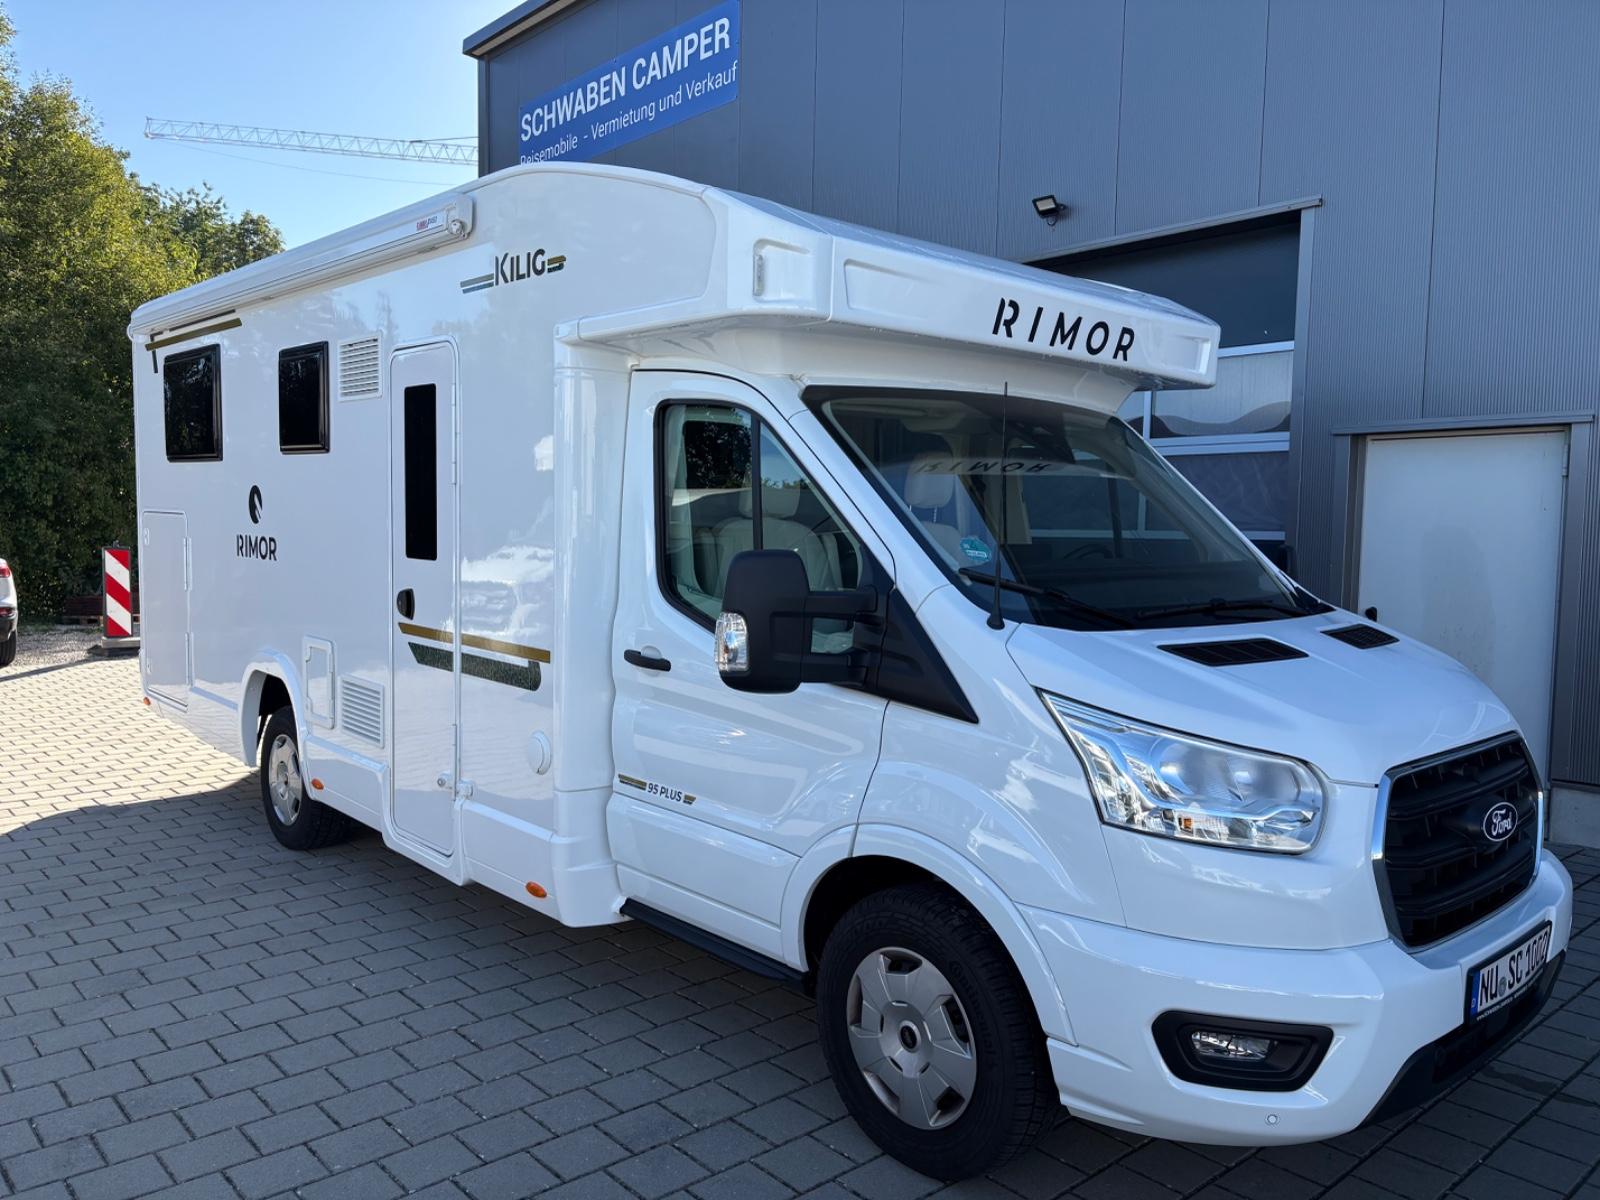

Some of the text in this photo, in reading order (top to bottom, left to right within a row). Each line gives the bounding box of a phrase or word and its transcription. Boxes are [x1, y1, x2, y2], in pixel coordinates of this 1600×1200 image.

[520, 17, 730, 142] SCHWABEN CAMPER
[591, 100, 656, 141] Vermietung
[659, 81, 682, 112] und
[686, 61, 738, 101] Verkauf
[494, 248, 546, 286] KILIG
[992, 297, 1135, 361] RIMOR
[236, 534, 278, 561] RIMOR
[647, 782, 683, 802] 95 PLUS
[1491, 808, 1512, 836] Ford
[1479, 964, 1499, 1007] NU
[1508, 950, 1523, 989] SC
